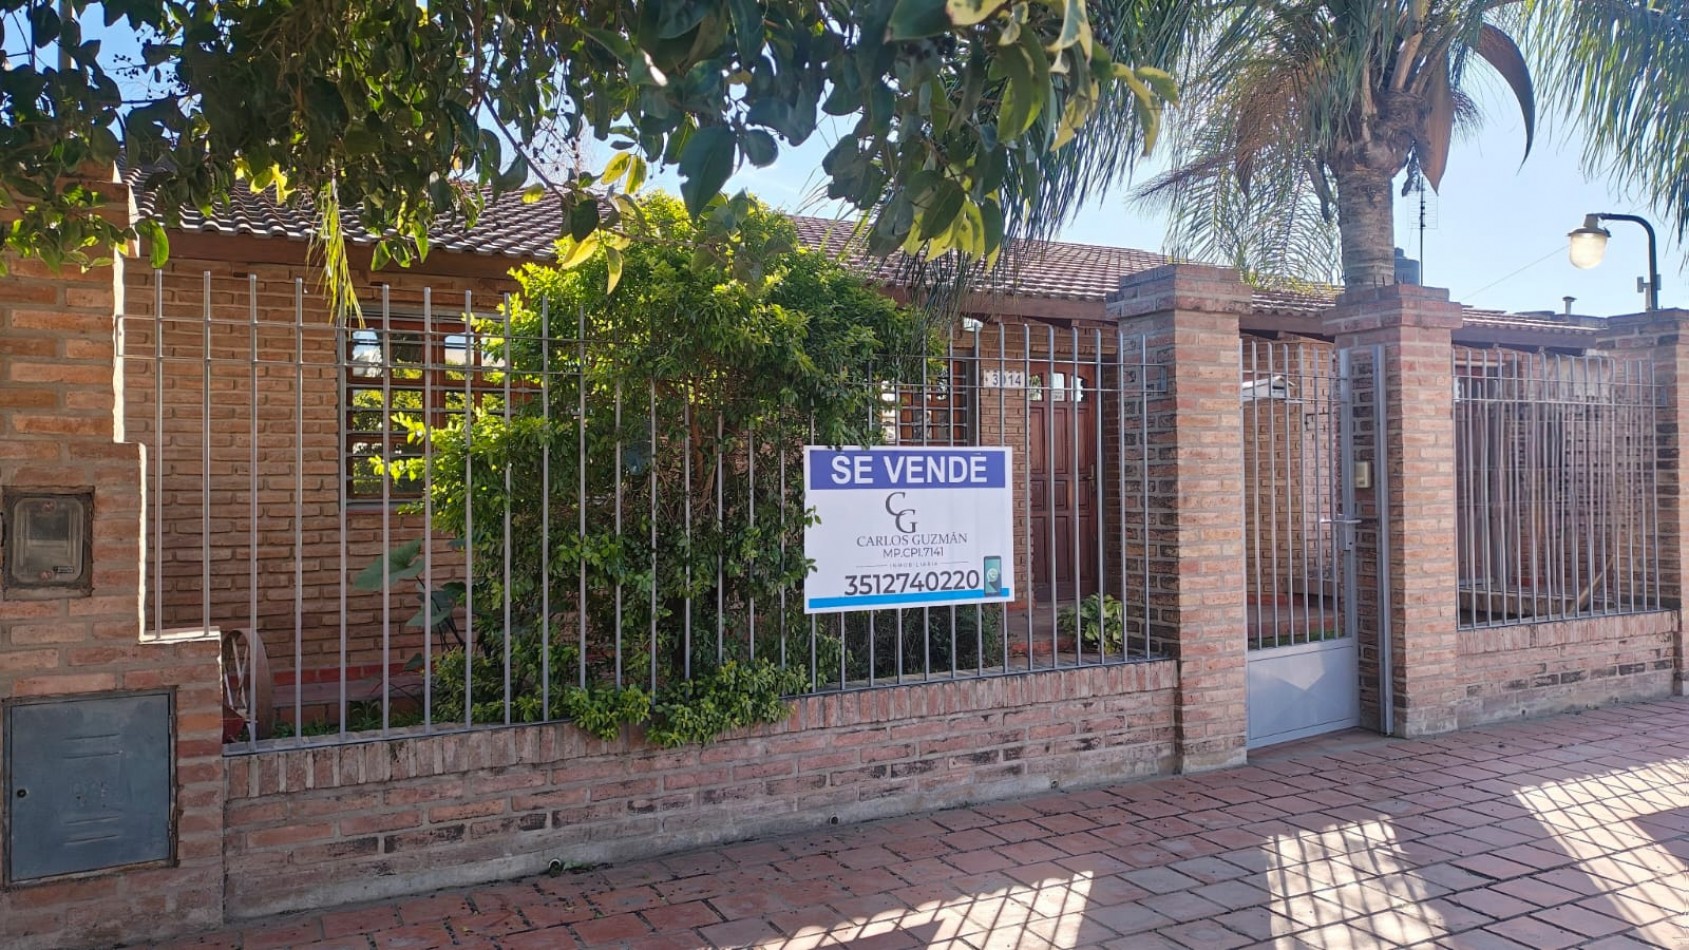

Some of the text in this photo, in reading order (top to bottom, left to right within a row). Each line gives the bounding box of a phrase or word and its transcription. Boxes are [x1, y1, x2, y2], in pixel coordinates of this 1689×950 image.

[831, 455, 987, 484] SE VENDE
[856, 532, 968, 547] CARLOS GUZMÁN
[844, 569, 980, 596] 3512740220
